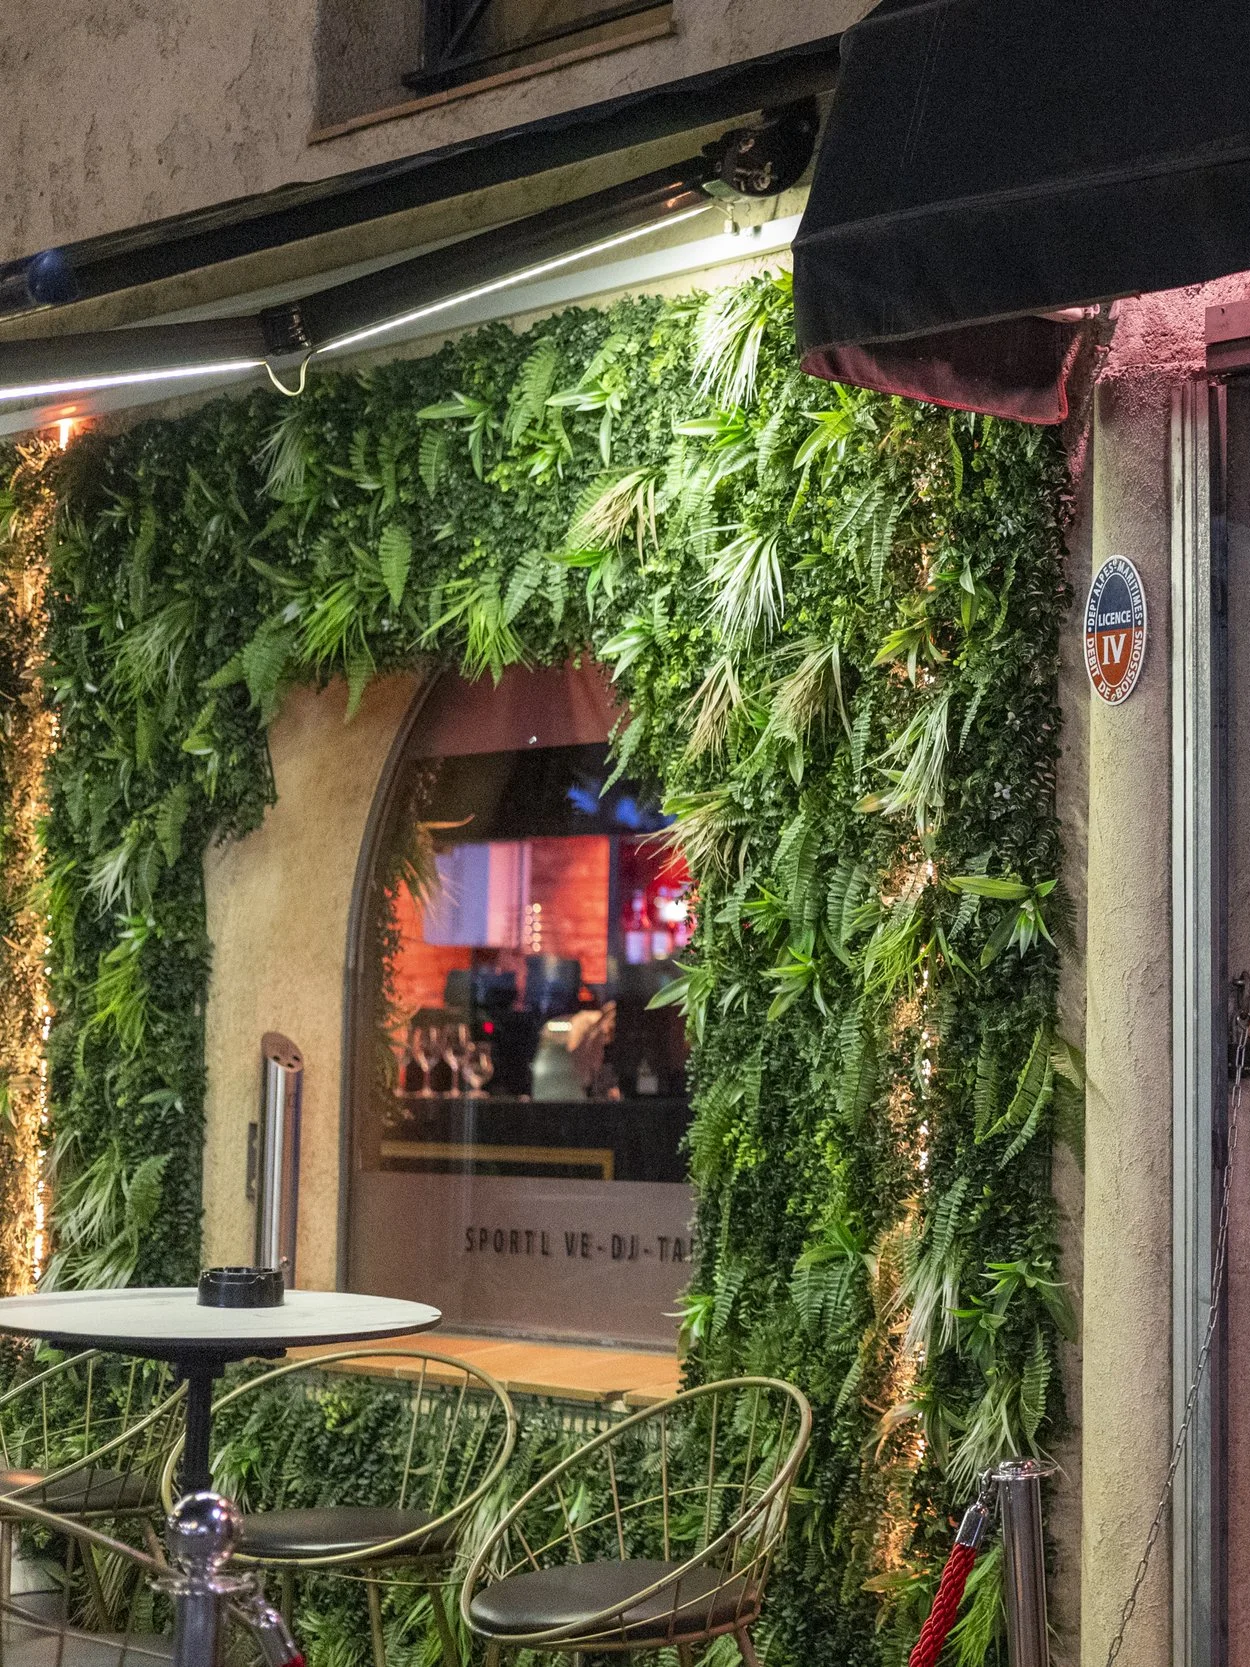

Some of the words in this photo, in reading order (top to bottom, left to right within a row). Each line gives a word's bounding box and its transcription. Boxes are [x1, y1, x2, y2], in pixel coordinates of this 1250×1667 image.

[1098, 610, 1132, 627] LICENCE
[1086, 637, 1100, 677] DEBIT
[1098, 681, 1111, 699] DE
[1116, 630, 1143, 698] BOISSONS
[1102, 633, 1127, 665] IV
